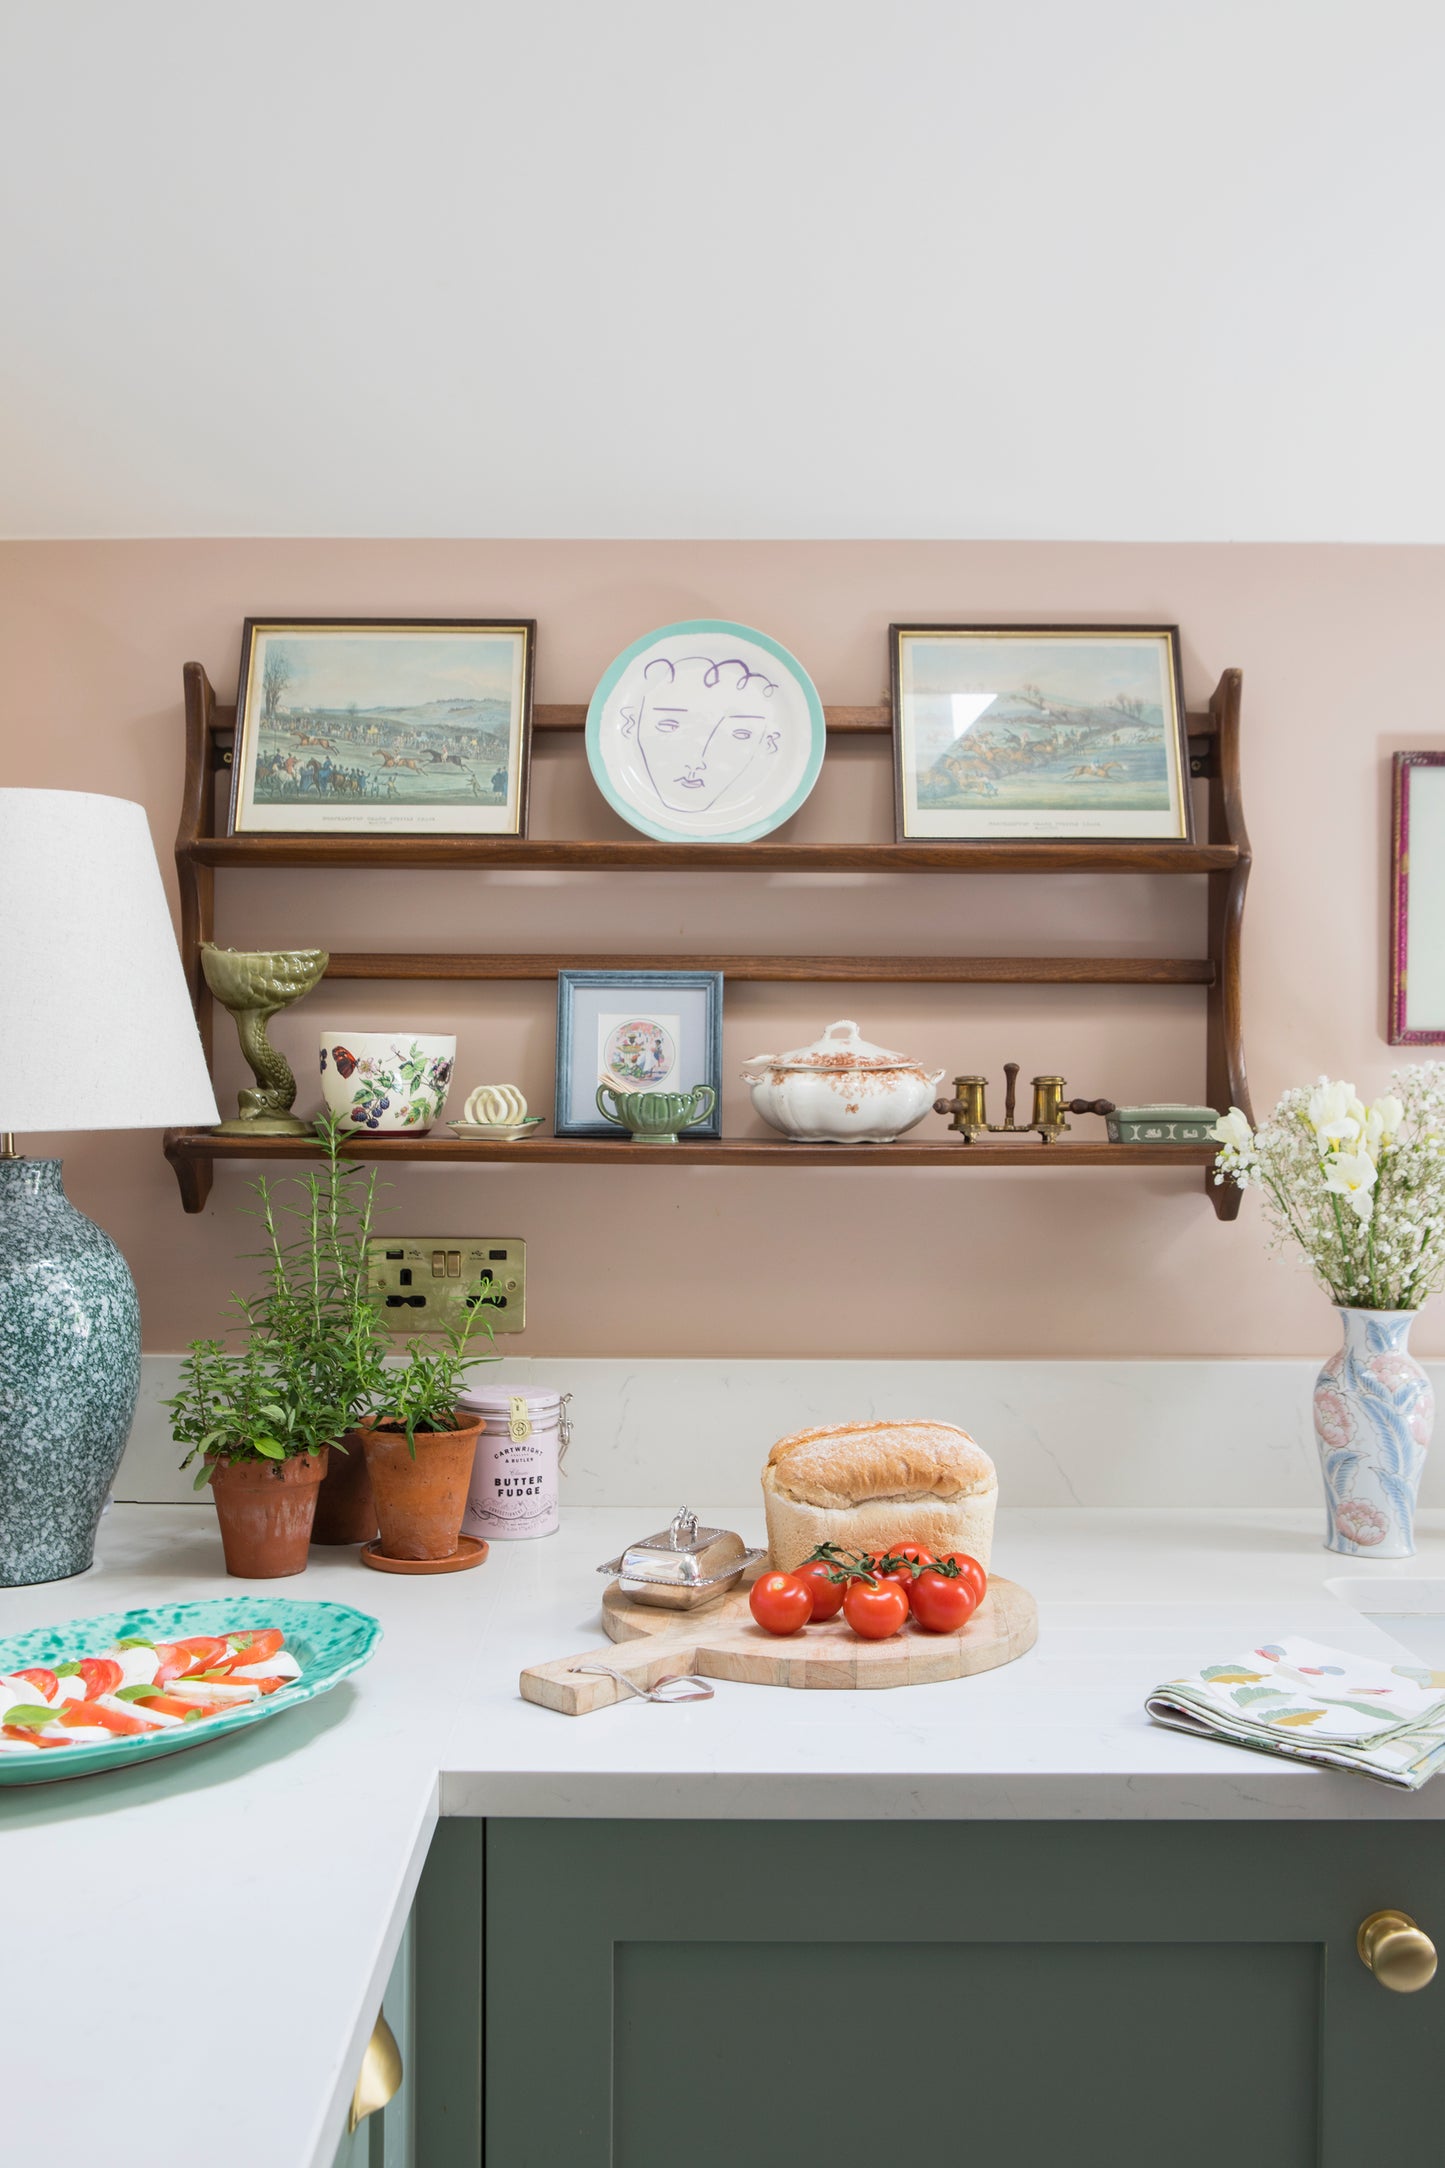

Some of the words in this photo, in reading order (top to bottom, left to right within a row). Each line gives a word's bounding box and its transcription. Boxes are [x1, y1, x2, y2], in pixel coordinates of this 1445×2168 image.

[494, 1446, 543, 1459] CARTWRIGHT
[494, 1475, 543, 1486] BUTTER
[497, 1486, 540, 1497] FUDGE
